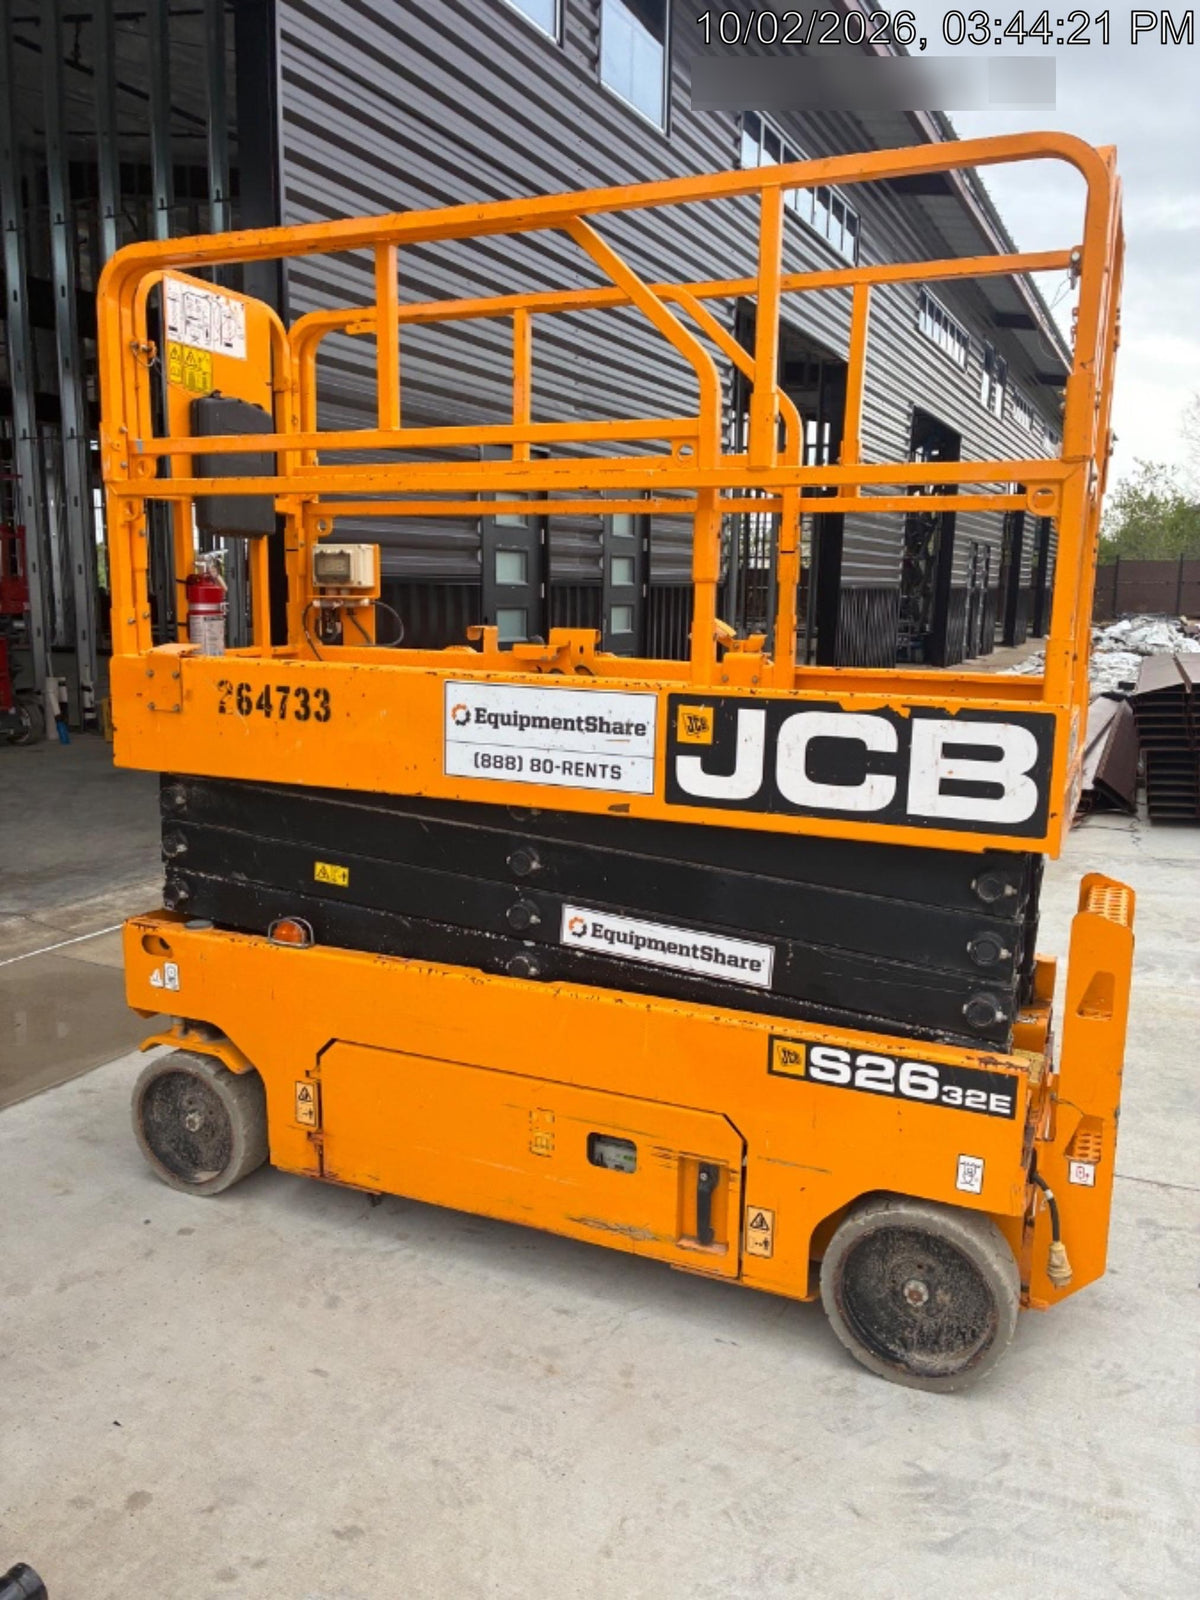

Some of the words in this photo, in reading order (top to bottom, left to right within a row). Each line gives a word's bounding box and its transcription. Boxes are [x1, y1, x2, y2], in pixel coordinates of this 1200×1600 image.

[218, 680, 331, 722] 264733
[474, 706, 647, 737] EquipmentShare
[474, 751, 523, 772] (888)
[530, 757, 622, 780] 80-RENTS
[675, 708, 1039, 824] JCB
[591, 922, 763, 972] EquipmentShare
